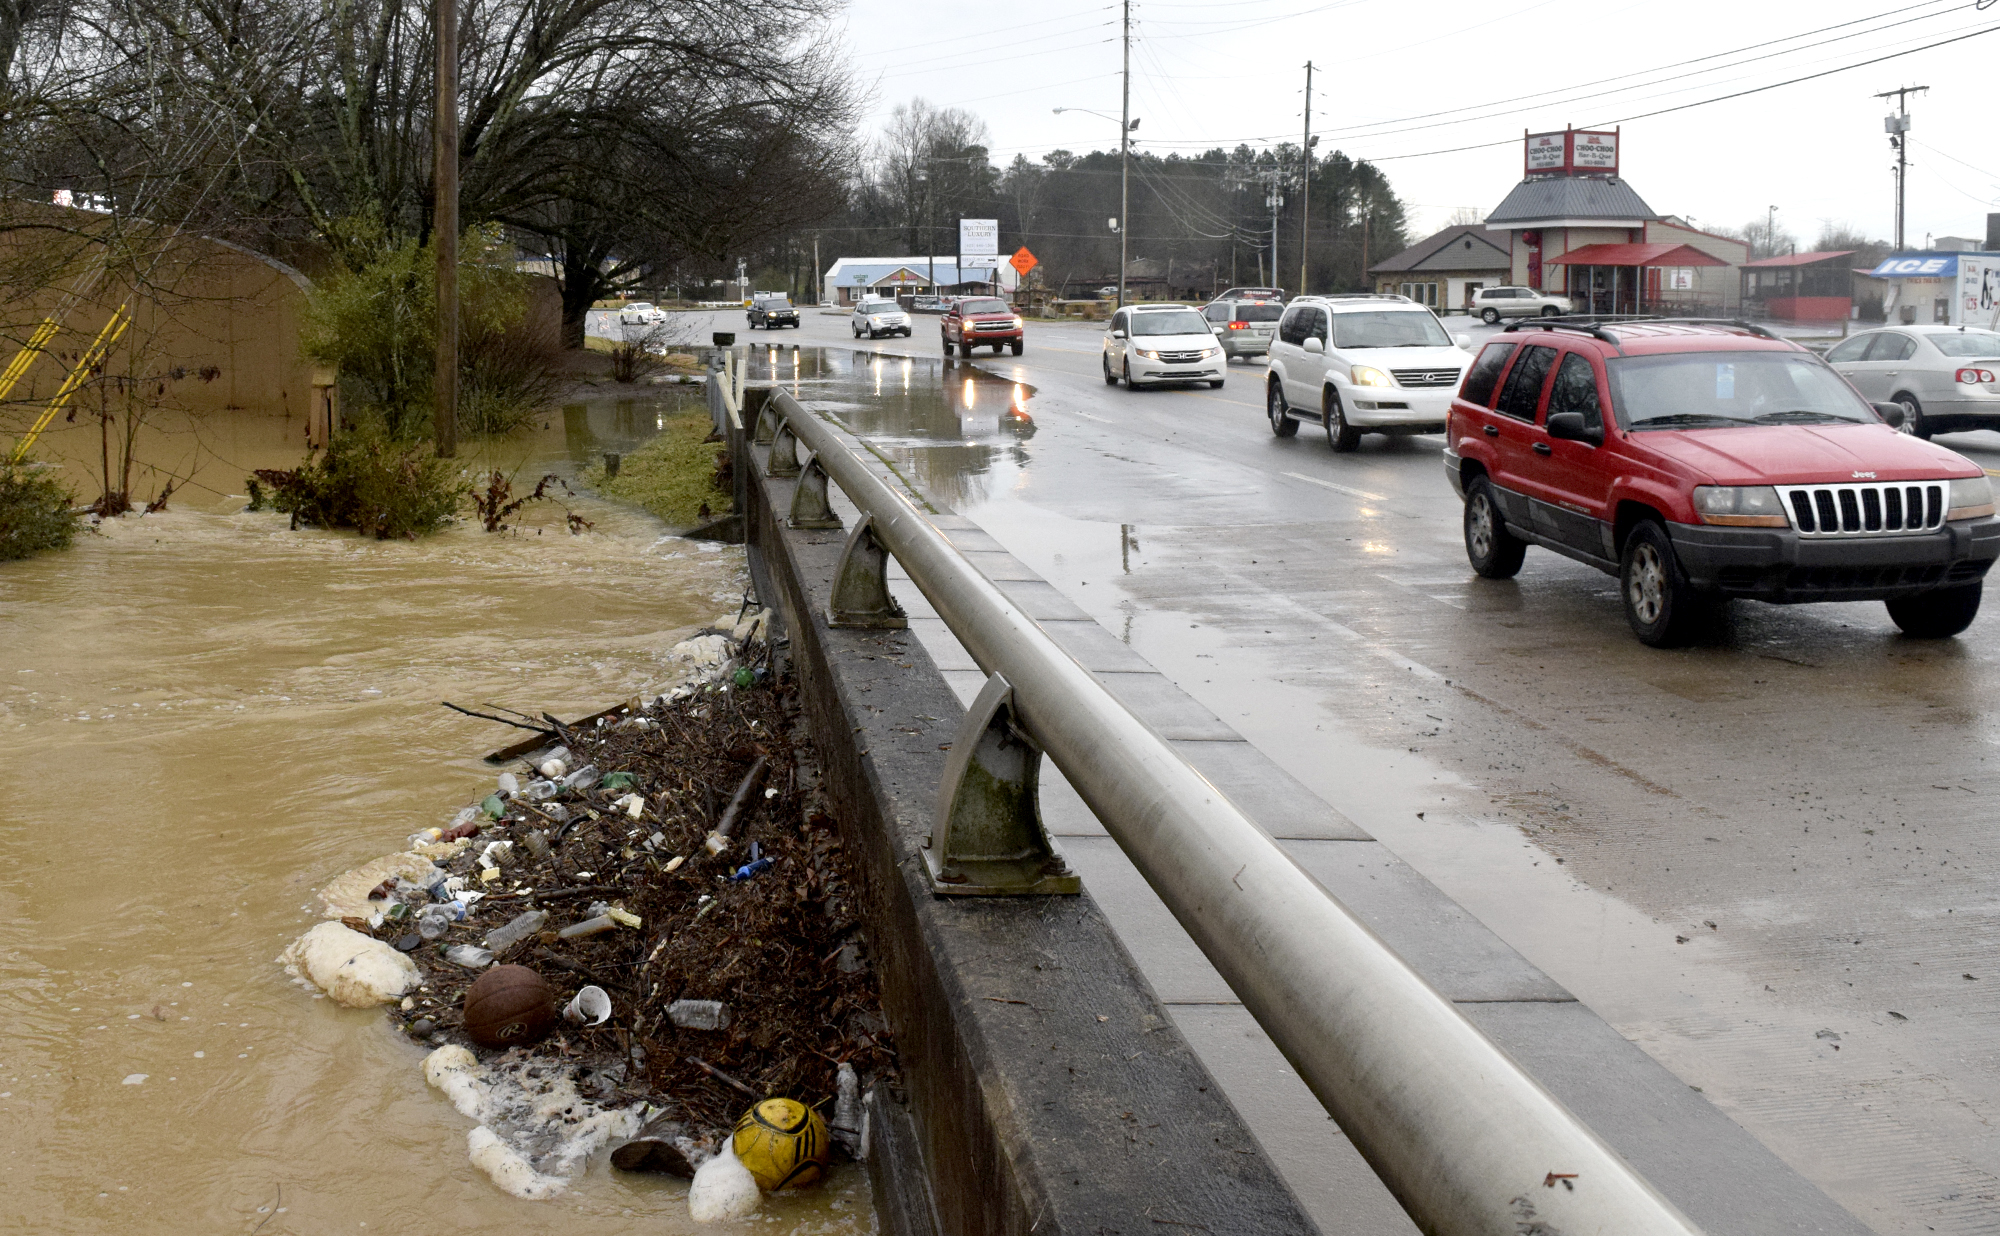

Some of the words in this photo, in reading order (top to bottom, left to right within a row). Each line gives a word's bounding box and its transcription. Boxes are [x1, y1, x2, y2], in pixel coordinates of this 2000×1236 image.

[1529, 145, 1563, 155] CHOO-CHOO
[1575, 144, 1614, 153] CHOO-CHOO
[1578, 152, 1611, 160] Bar-B-Que
[1879, 259, 1948, 273] ICE
[1851, 470, 1877, 479] Jeep
